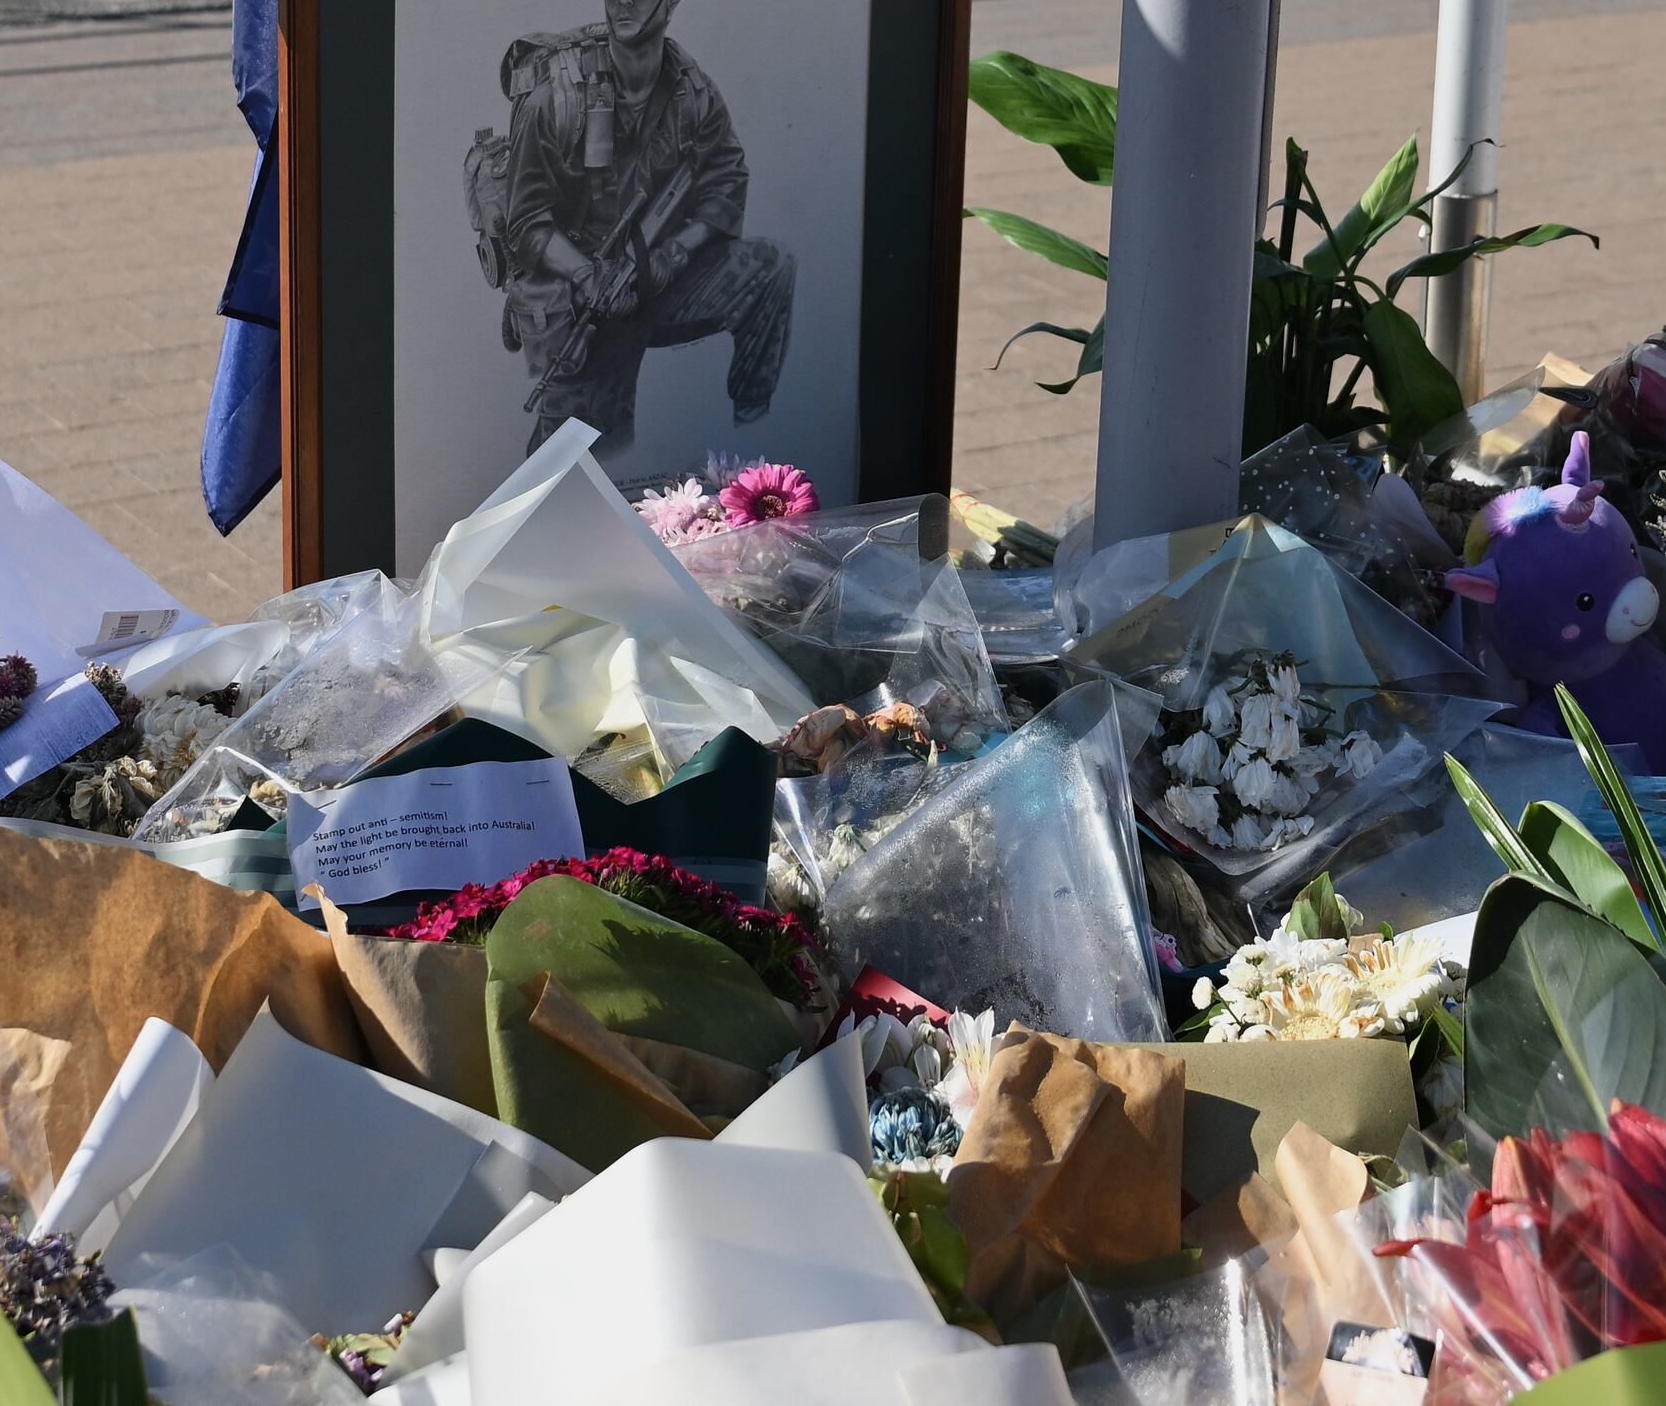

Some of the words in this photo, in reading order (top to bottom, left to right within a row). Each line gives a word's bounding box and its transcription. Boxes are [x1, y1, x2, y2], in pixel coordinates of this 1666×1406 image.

[313, 828, 346, 841] Stamp
[348, 823, 366, 834] out
[368, 818, 388, 829] anti
[399, 811, 448, 822] semitism!
[316, 842, 338, 854] May
[340, 837, 358, 848] the
[360, 833, 383, 846] light
[385, 829, 398, 839] be
[401, 824, 440, 836] brought
[443, 824, 466, 834] back
[468, 822, 488, 833] into
[491, 820, 535, 831] Australia!
[318, 857, 341, 867] May
[343, 853, 366, 863] your
[369, 843, 412, 857] memory
[414, 838, 427, 848] be
[429, 838, 468, 848] eternal!
[328, 867, 350, 878] God
[353, 859, 382, 875] bless!
